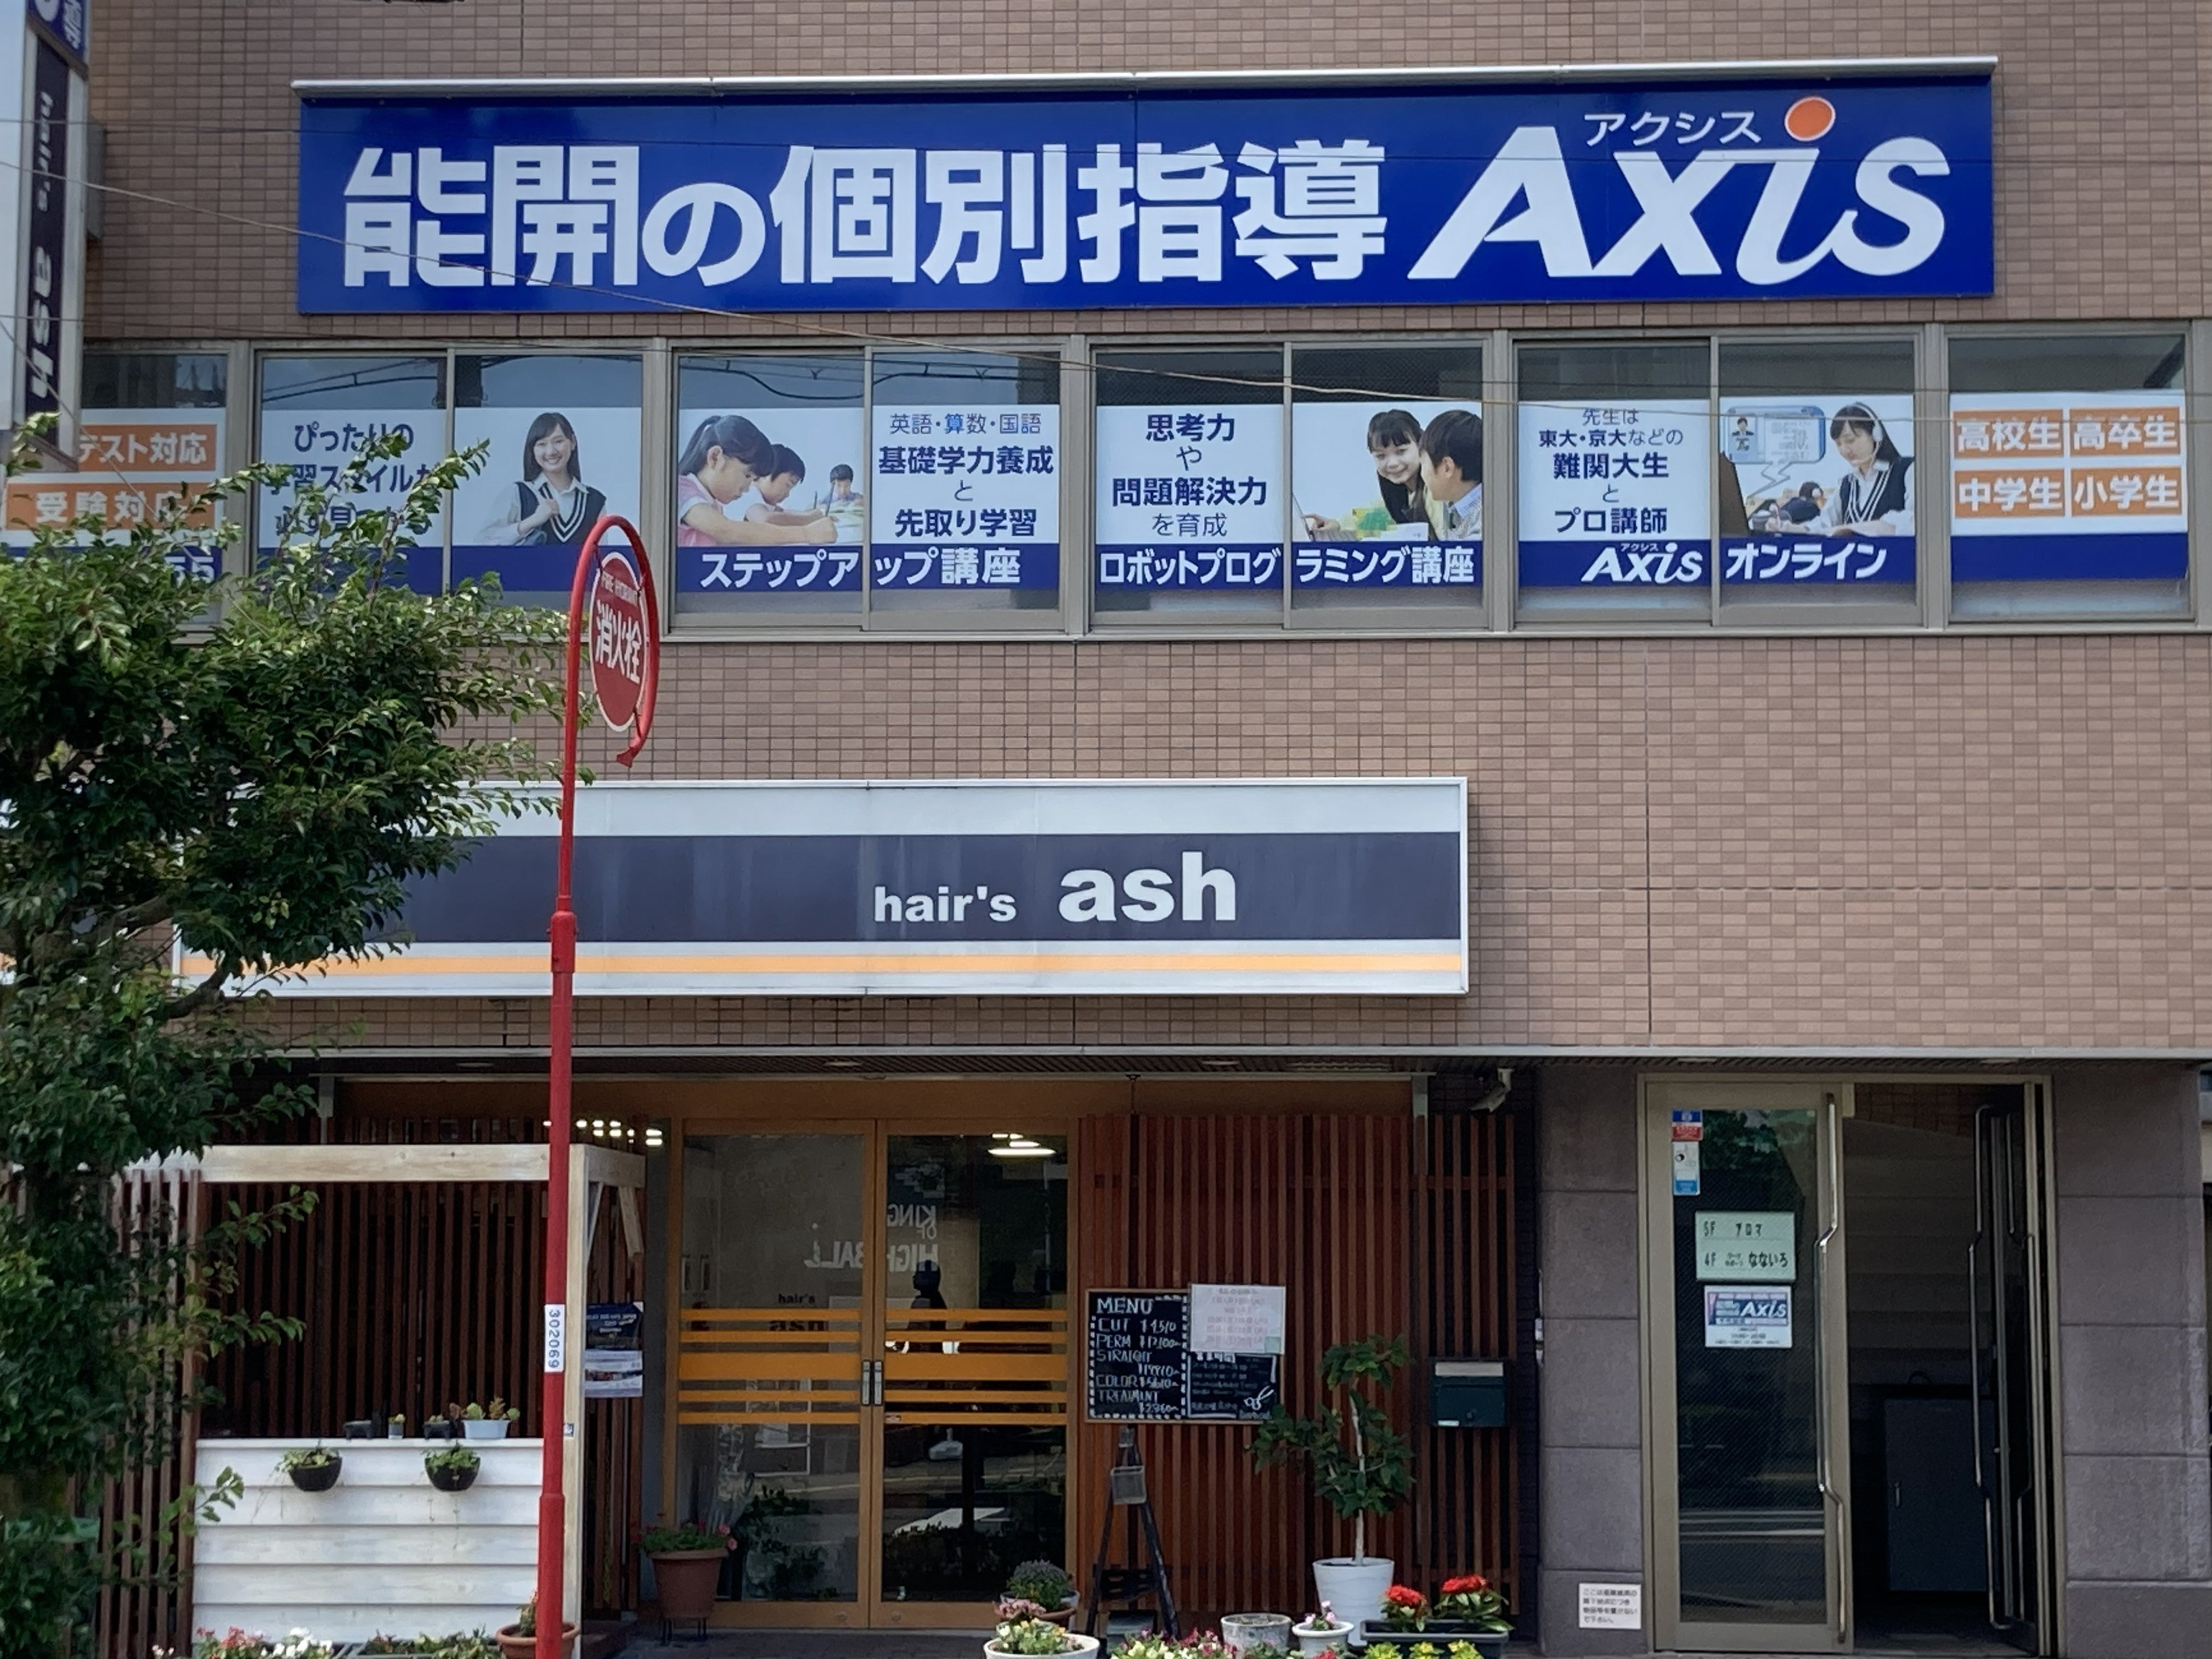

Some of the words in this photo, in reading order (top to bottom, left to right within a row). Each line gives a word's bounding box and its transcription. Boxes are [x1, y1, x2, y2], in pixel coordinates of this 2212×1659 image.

[1584, 111, 1761, 146] アクシス
[343, 139, 1387, 287] 能開の個別指導
[1407, 97, 1950, 285] Axis
[31, 246, 53, 399] ash
[890, 413, 1042, 435] 英語・算数・国語
[1146, 413, 1235, 441] 思考力
[1582, 408, 1638, 425] 先生は
[1538, 429, 1683, 447] 東大・京大などの
[1957, 416, 2061, 452] 高校生
[2073, 414, 2177, 450] 高卒生
[879, 446, 1054, 475] 基礎学力養成
[1176, 446, 1201, 470] や
[1553, 452, 1669, 478] 難関大生
[955, 481, 973, 501] と
[1112, 477, 1267, 506] 問題解決力
[1602, 484, 1619, 503] と
[1959, 476, 2062, 512] 中学生
[2074, 475, 2179, 509] 小学生
[895, 509, 1036, 537] 先取り学習
[1152, 513, 1227, 537] を育成
[1555, 507, 1667, 534] プロ講師
[1581, 542, 1702, 584] Axis
[1725, 543, 1887, 579] オンライン
[595, 600, 642, 684] 消火栓
[874, 885, 1017, 922] hair's
[1058, 851, 1235, 922] ash
[1748, 1251, 1788, 1267] なないろ
[778, 1293, 816, 1304] hair's
[1098, 1297, 1154, 1314] MENU
[1740, 1300, 1787, 1317] Axis
[1098, 1318, 1130, 1332] CUT
[548, 1310, 560, 1368] 302069
[1097, 1334, 1131, 1348] PERM
[1096, 1375, 1138, 1388] COLOR
